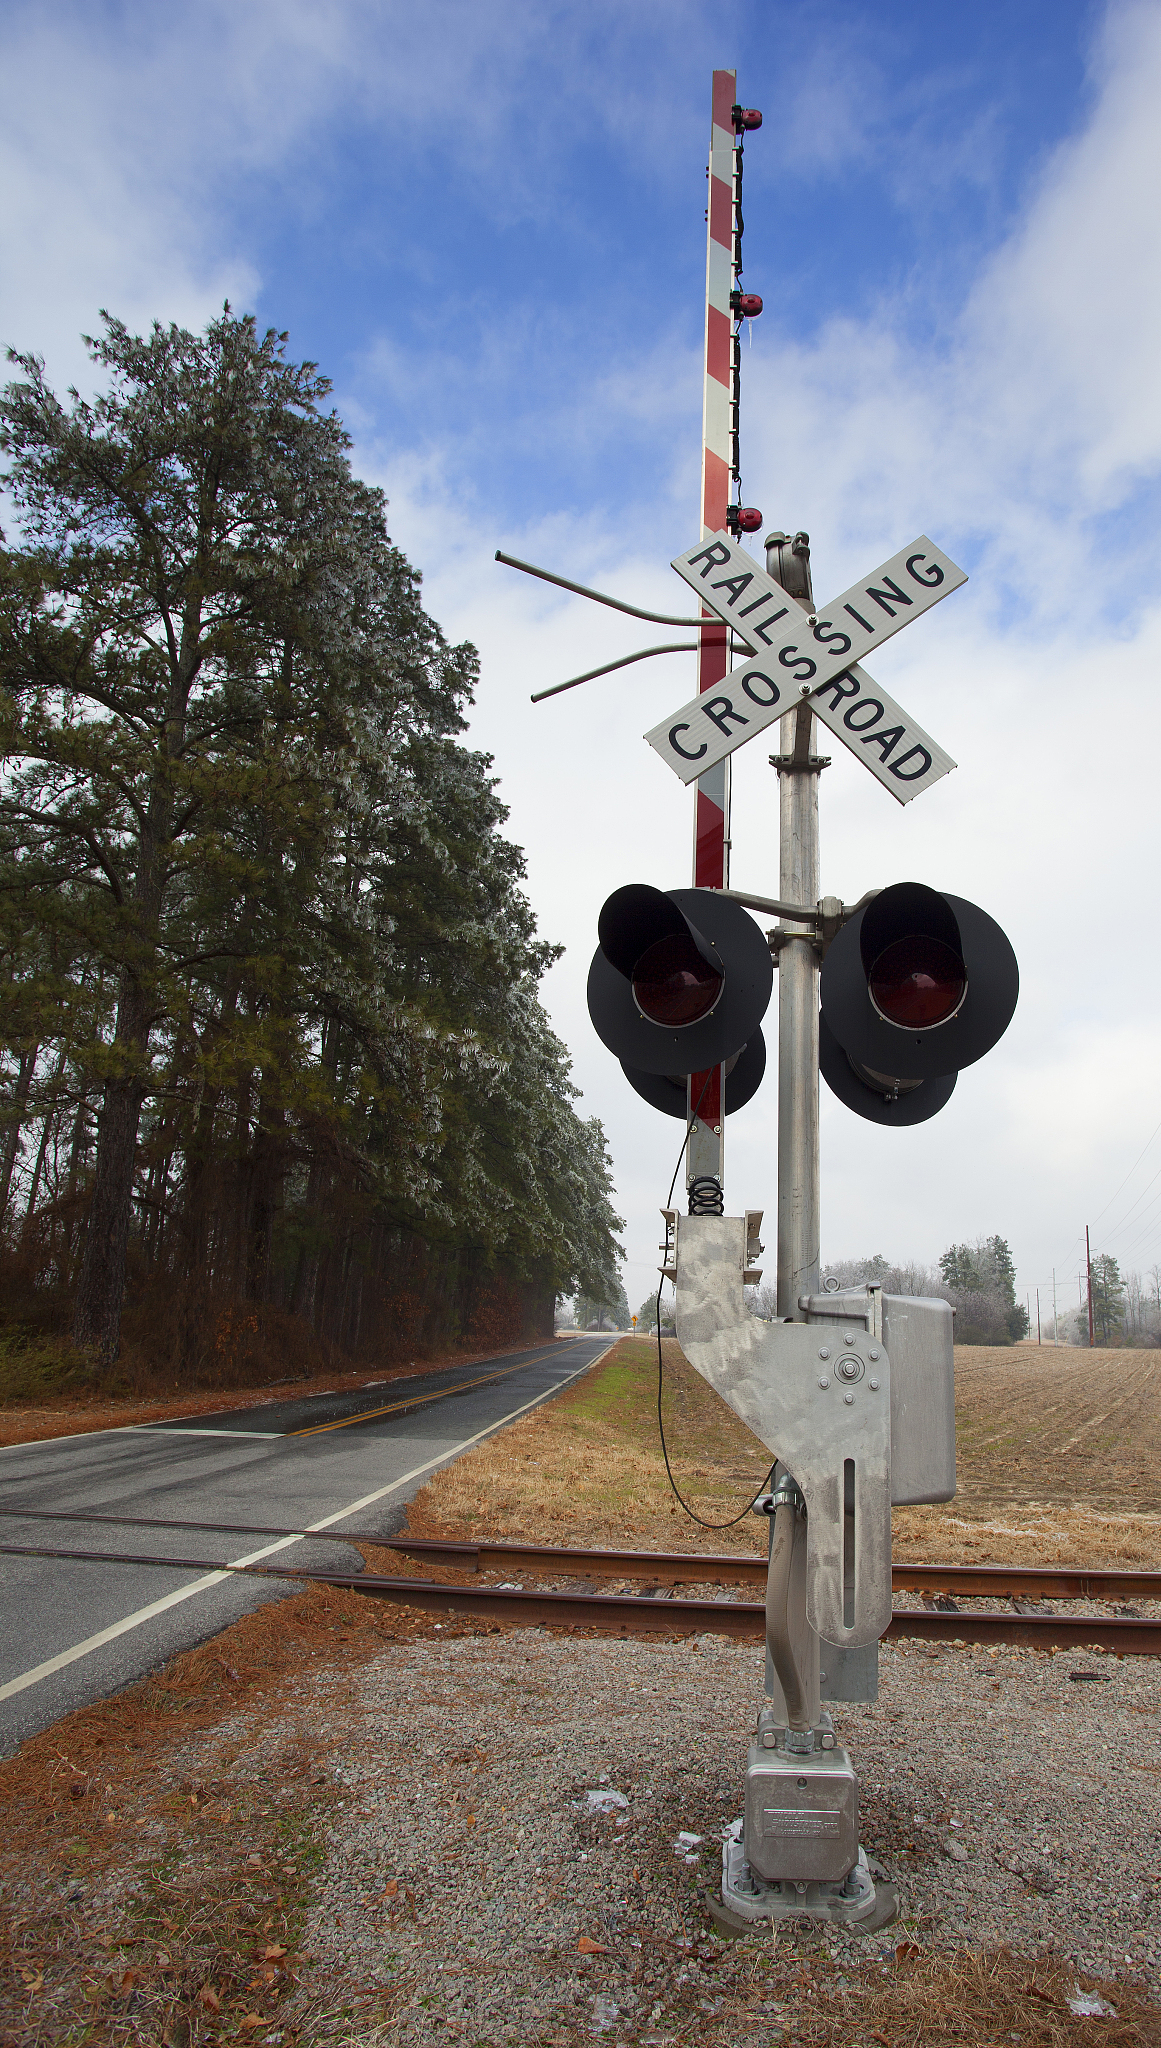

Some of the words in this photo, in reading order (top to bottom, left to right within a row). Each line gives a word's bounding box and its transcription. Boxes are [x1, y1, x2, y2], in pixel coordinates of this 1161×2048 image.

[668, 554, 944, 760] CROSSING
[688, 541, 789, 645] RAIL
[815, 670, 932, 781] ROAD
